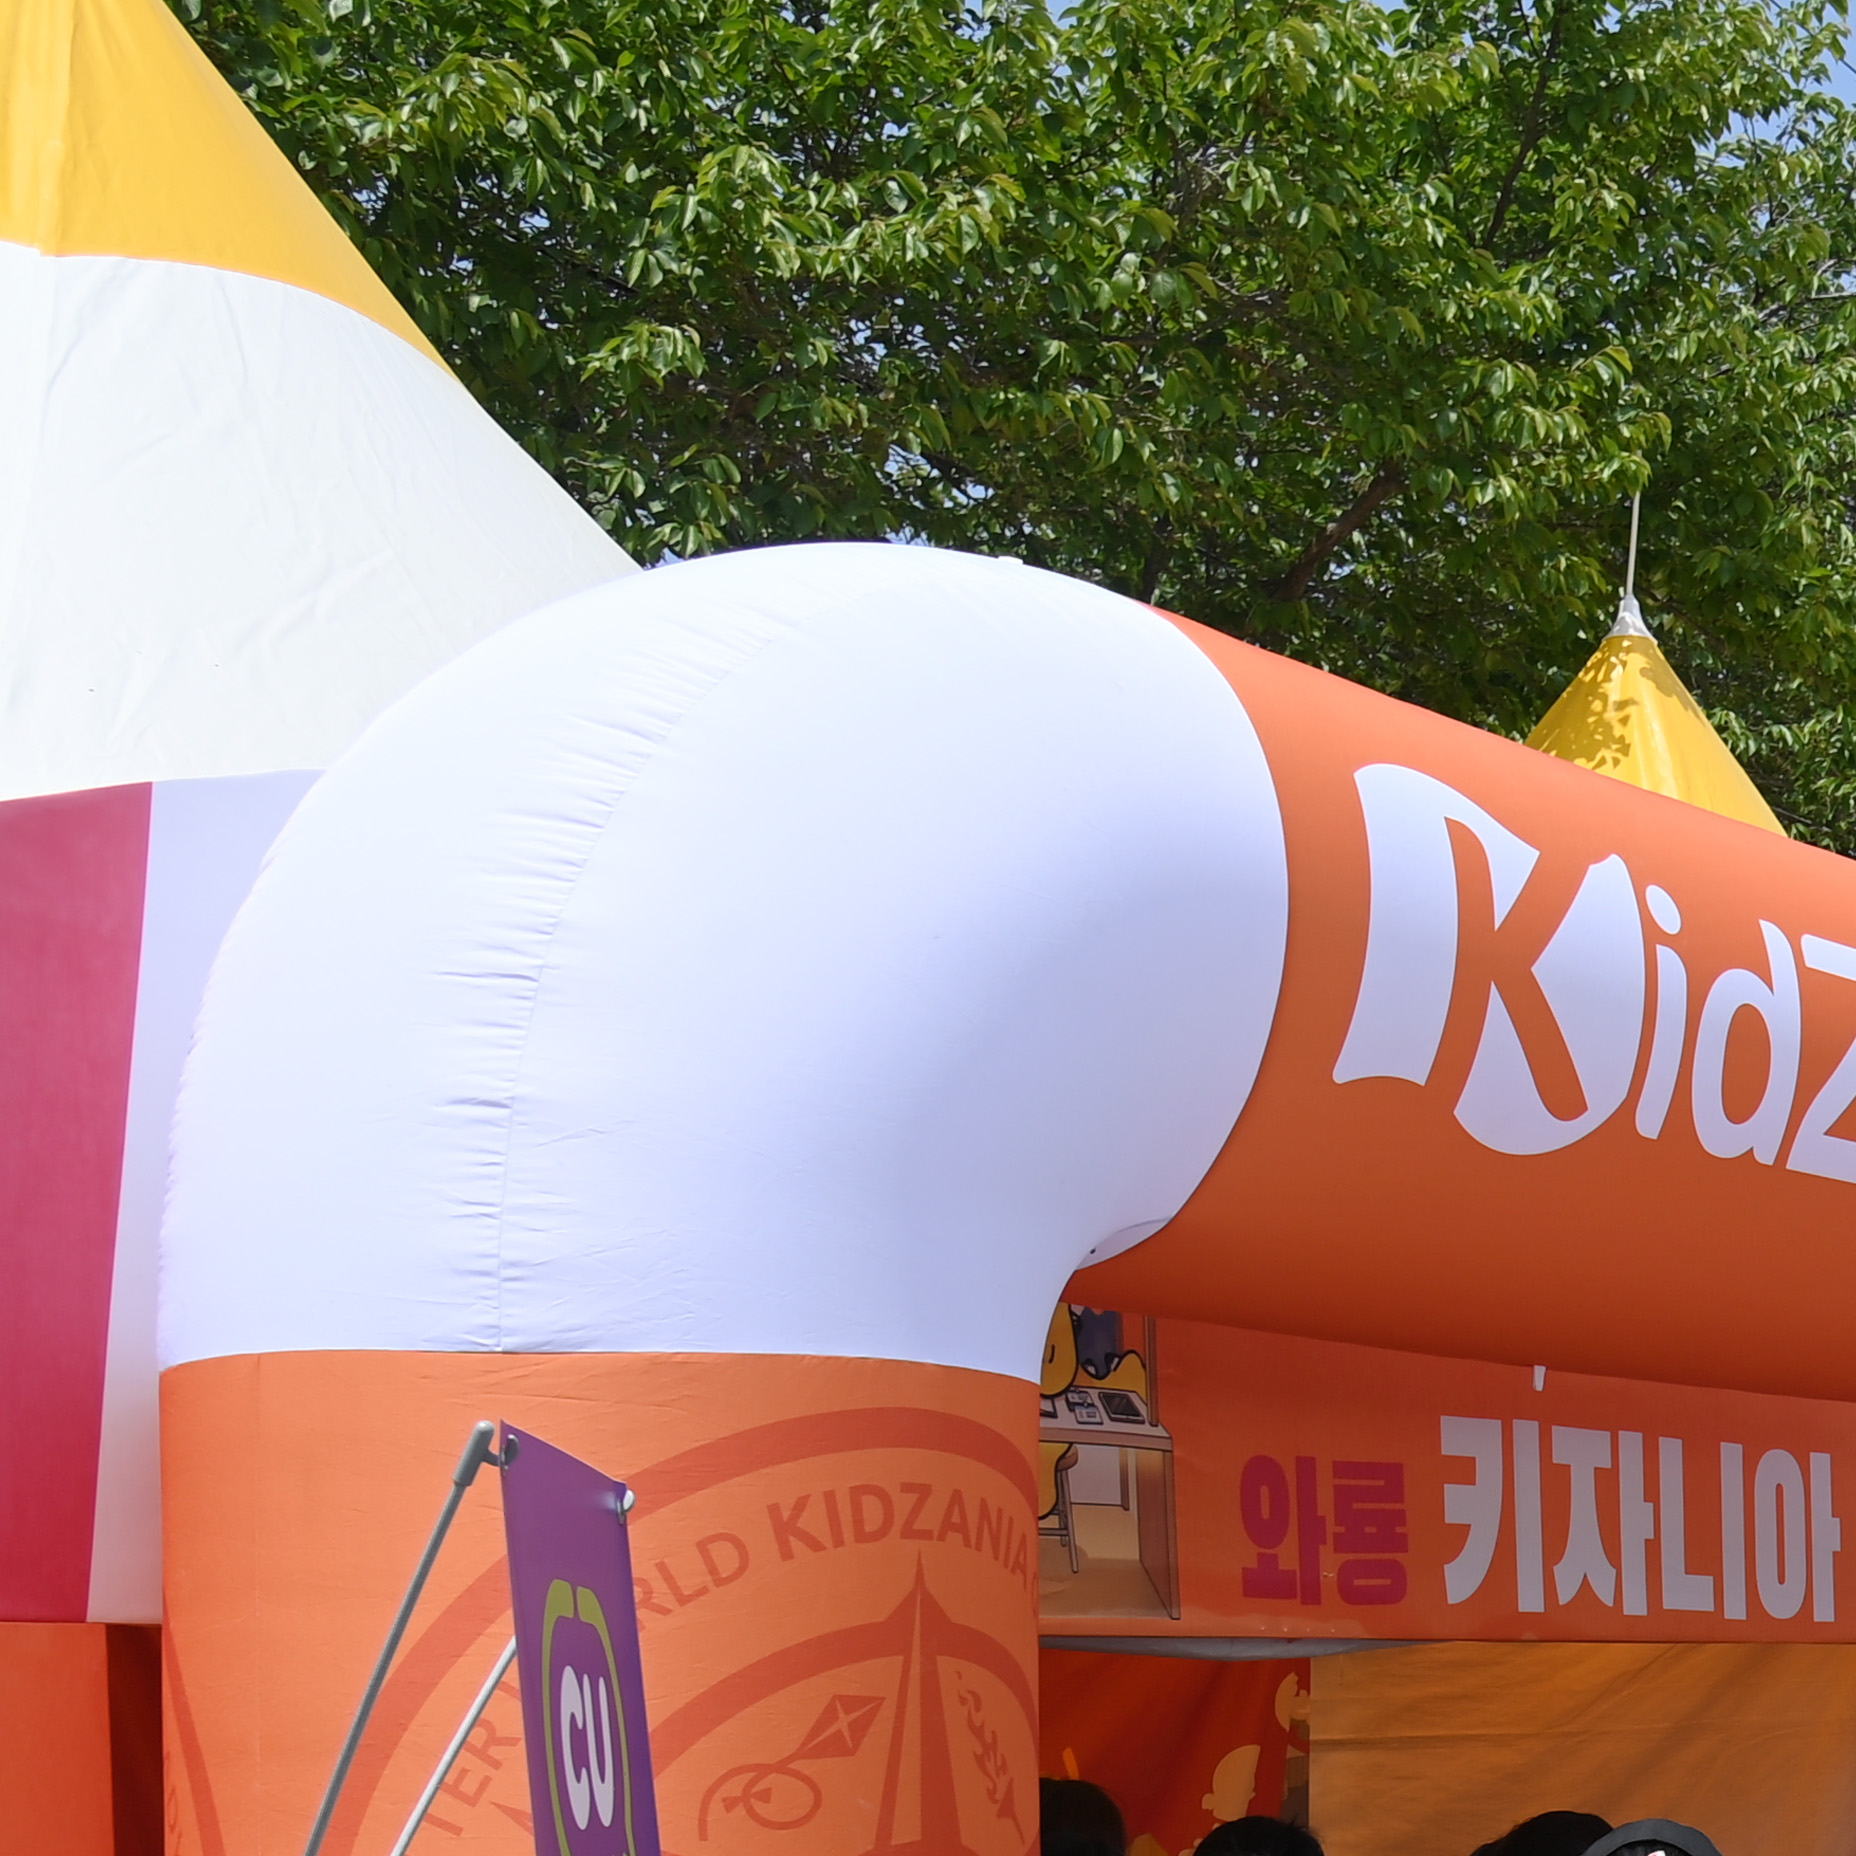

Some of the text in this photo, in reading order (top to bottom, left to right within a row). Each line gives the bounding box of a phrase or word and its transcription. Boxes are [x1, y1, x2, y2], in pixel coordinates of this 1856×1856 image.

[633, 1532, 750, 1620] RLD
[766, 1481, 1029, 1592] KIDZANIA
[1240, 1455, 1409, 1606] 와룡
[1441, 1414, 1840, 1623] 키자니아
[559, 1663, 617, 1830] CU
